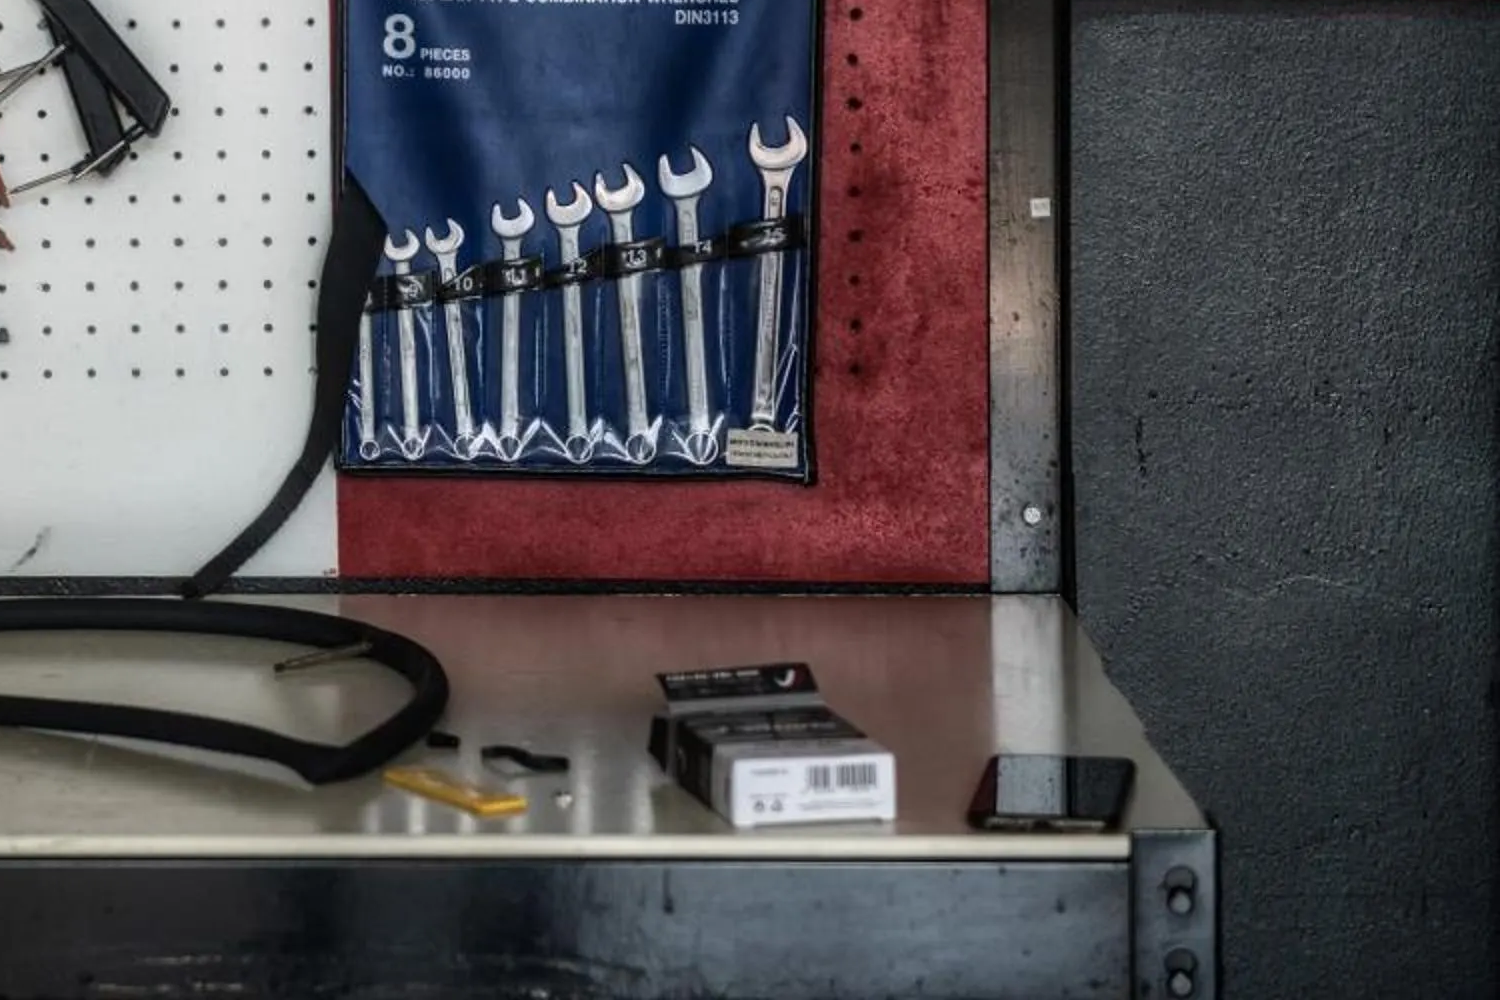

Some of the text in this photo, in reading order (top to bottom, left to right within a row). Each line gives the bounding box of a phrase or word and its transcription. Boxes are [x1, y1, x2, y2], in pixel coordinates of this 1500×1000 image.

[675, 9, 740, 25] DIN3113
[382, 13, 471, 62] 8 PIECES
